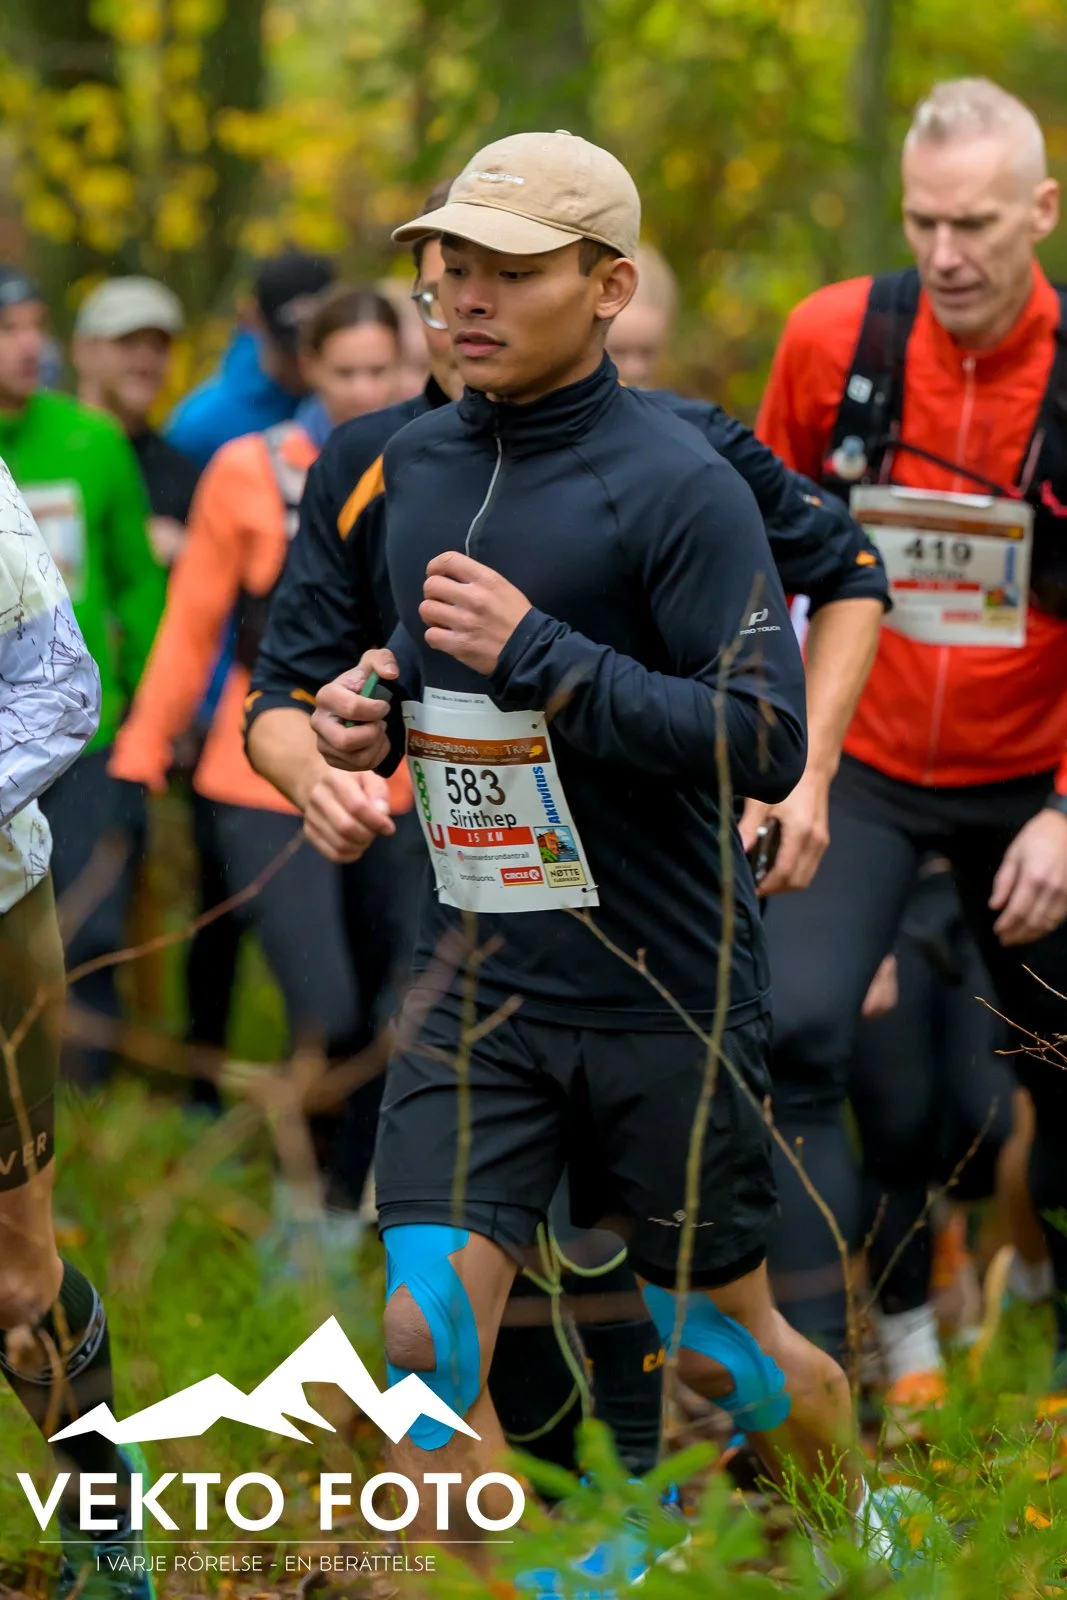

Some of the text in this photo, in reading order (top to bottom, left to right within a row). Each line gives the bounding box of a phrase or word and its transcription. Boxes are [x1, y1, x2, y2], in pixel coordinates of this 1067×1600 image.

[904, 536, 974, 566] 419
[444, 766, 506, 807] 583
[532, 766, 561, 825] Aktivitus
[450, 808, 517, 830] Sirithep
[467, 831, 504, 843] 15 KM
[550, 868, 580, 878] NØTTE
